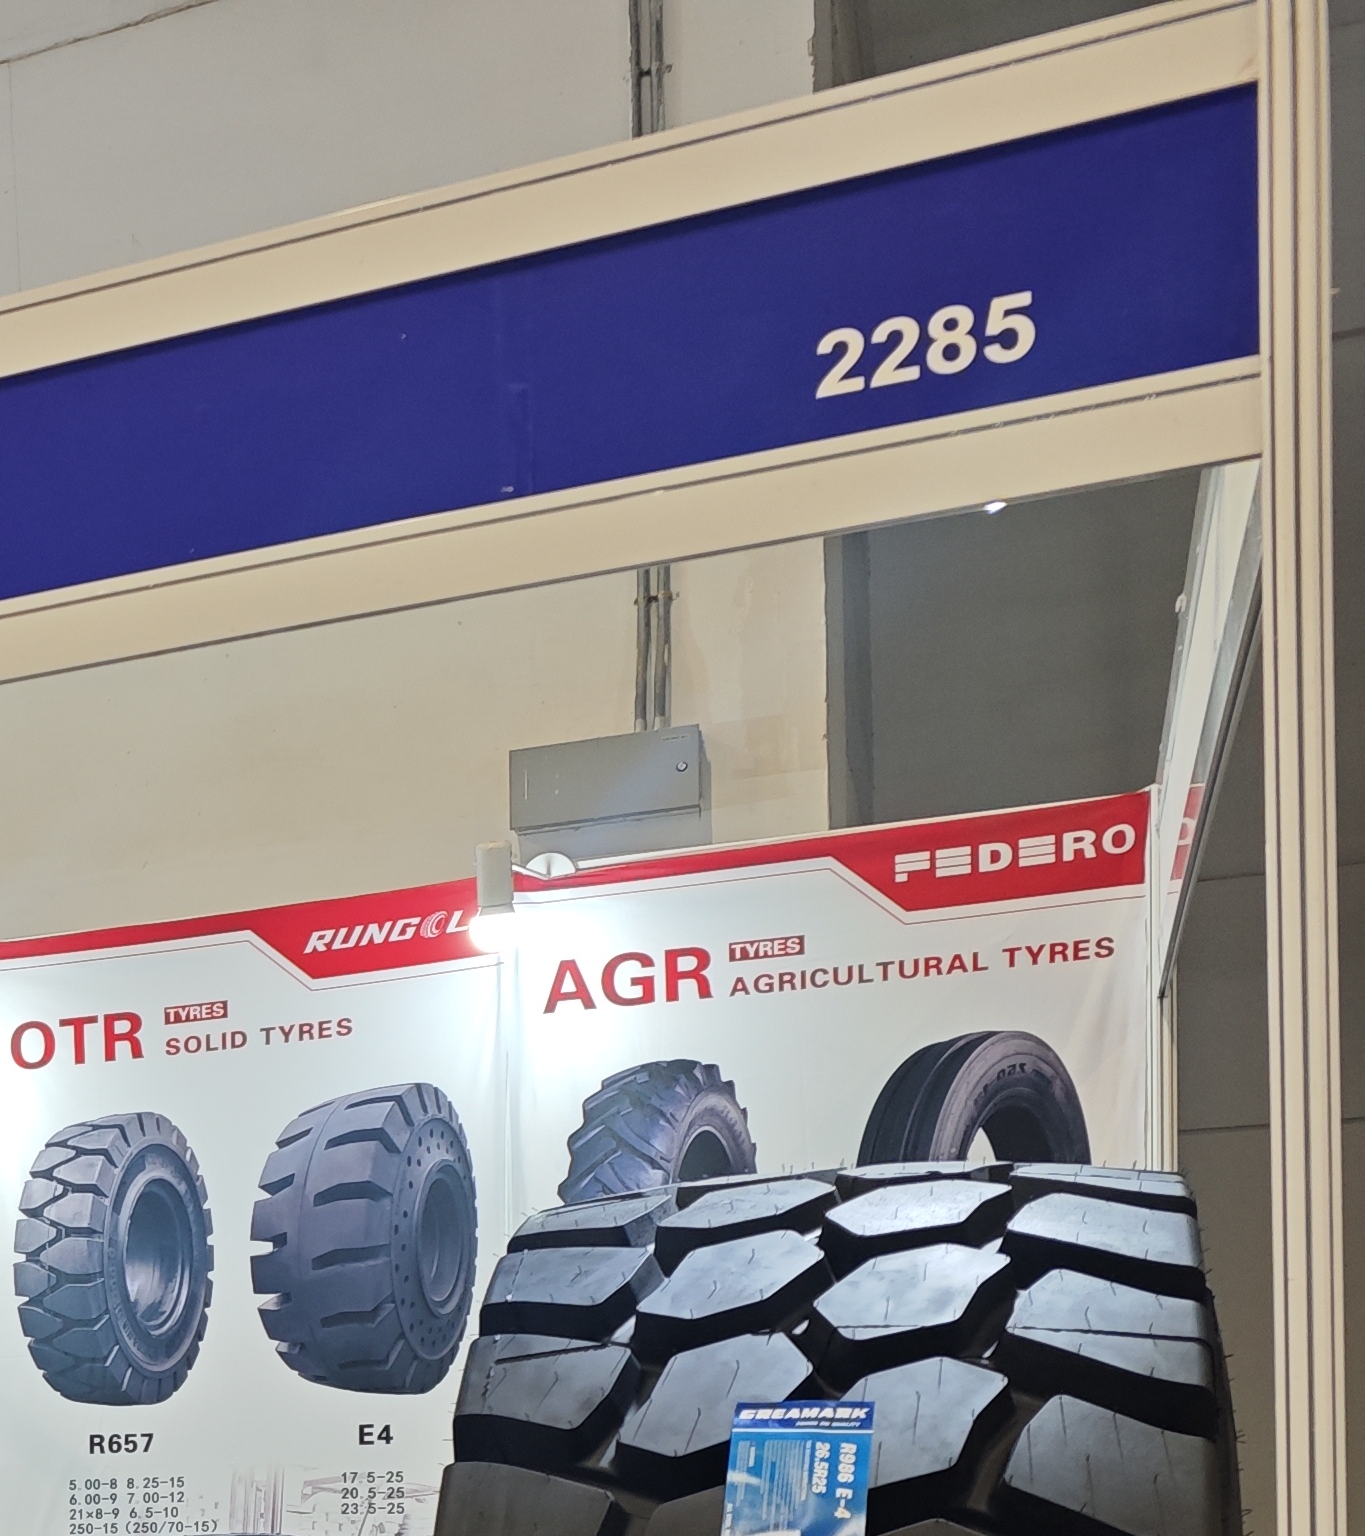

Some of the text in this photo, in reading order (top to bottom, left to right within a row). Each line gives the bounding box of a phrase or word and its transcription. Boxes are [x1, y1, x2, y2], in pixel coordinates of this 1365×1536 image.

[816, 290, 1036, 400] 2285
[894, 824, 1136, 883] FEDERO
[731, 937, 801, 959] TYRES
[543, 946, 713, 1015] AGR
[729, 936, 1115, 998] AGRICULTURAL TYRES
[168, 1003, 225, 1021] TYRES
[10, 1012, 145, 1070] OTR
[165, 1018, 353, 1057] SOLID TYRES
[739, 1408, 870, 1420] GREAMARK
[89, 1433, 154, 1454] R657
[358, 1424, 393, 1445] E4
[834, 1489, 853, 1519] E-4
[69, 1522, 118, 1535] 250-15
